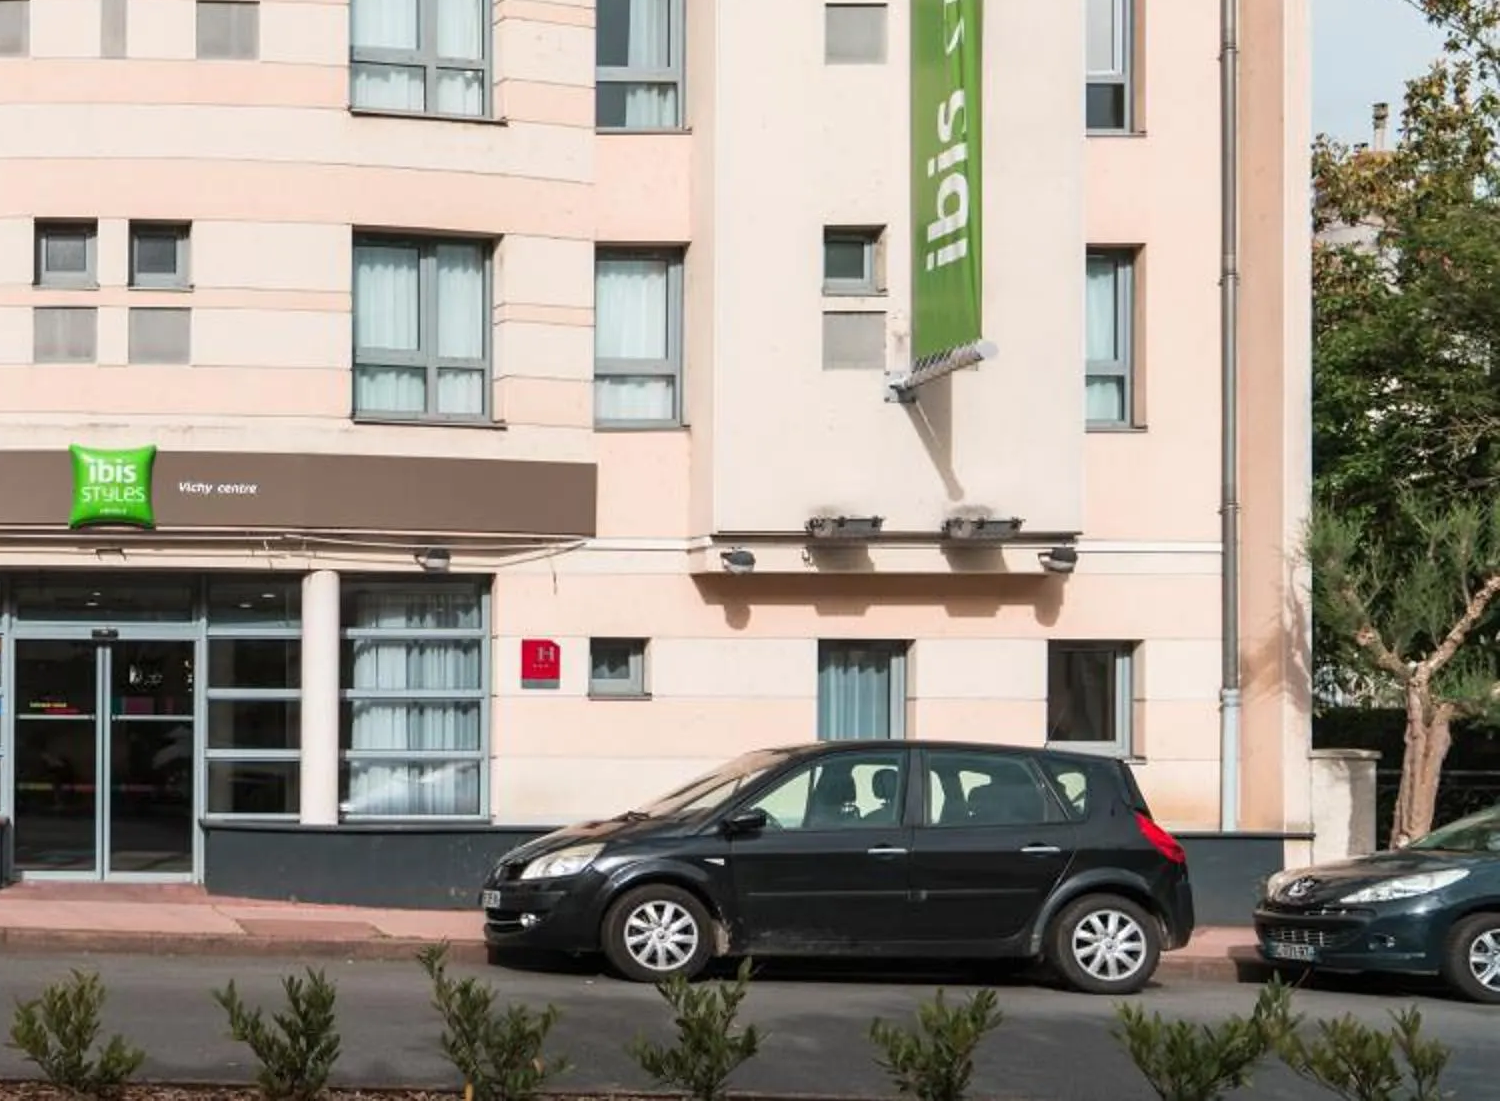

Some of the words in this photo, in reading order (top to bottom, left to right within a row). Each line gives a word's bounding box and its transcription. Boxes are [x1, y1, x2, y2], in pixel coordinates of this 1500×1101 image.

[926, 89, 969, 273] ibis
[88, 458, 137, 483] ibis
[179, 482, 213, 495] Vichy
[217, 483, 258, 494] centre
